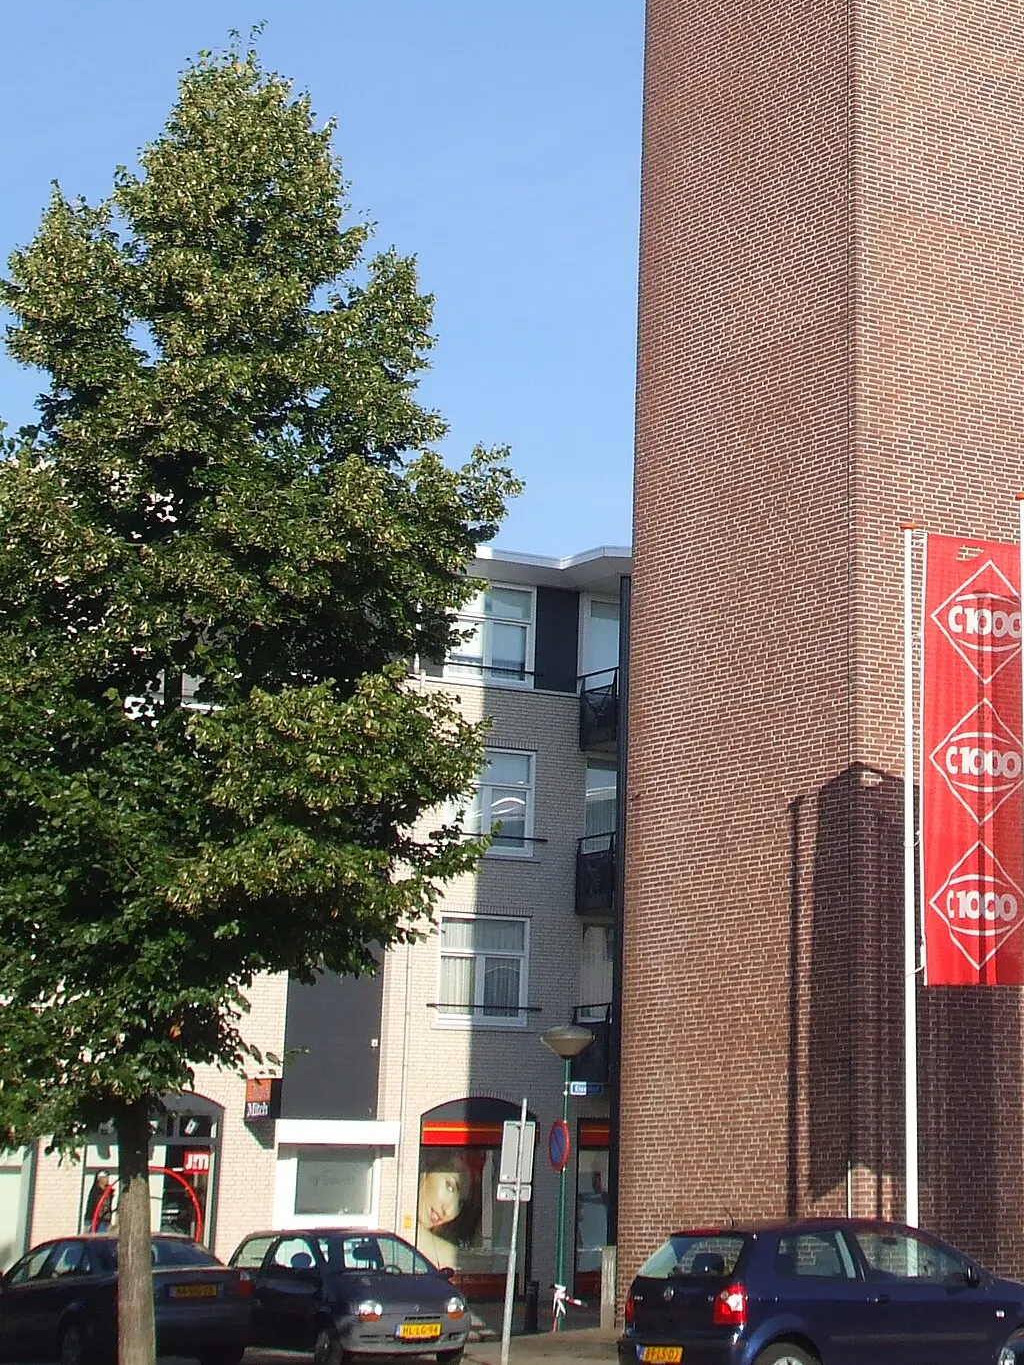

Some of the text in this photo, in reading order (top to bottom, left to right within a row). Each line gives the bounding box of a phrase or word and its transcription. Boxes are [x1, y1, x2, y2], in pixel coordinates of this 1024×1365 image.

[948, 605, 1022, 638] C1000
[945, 745, 1022, 778] C1000
[946, 890, 1017, 921] C1000
